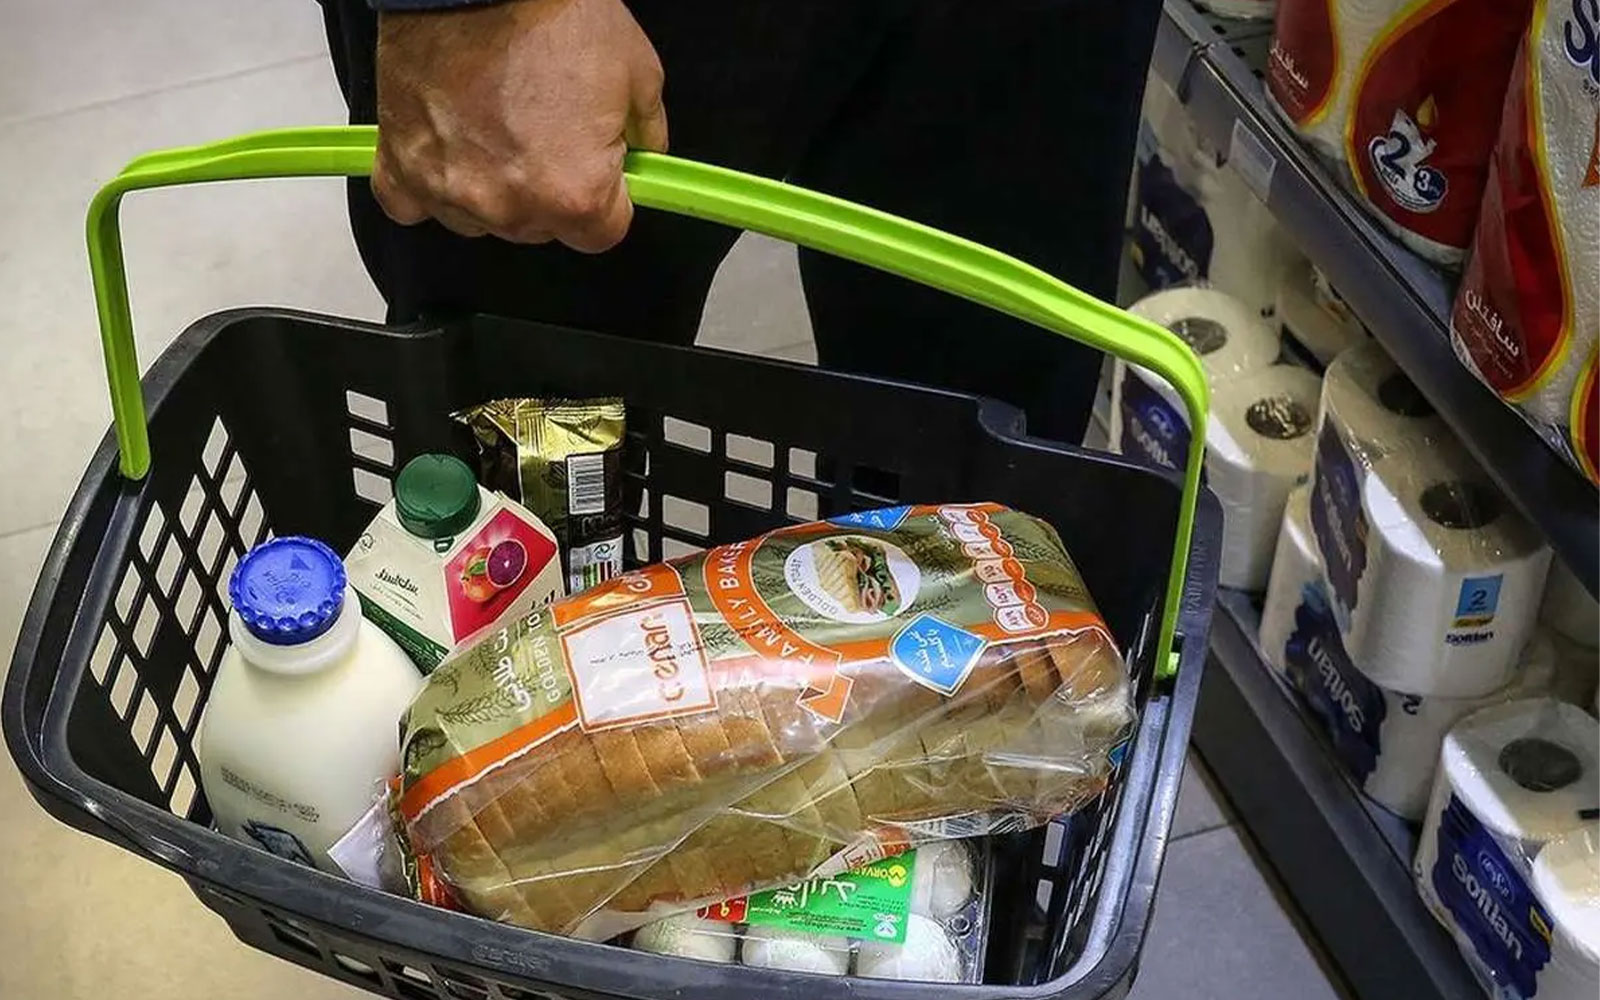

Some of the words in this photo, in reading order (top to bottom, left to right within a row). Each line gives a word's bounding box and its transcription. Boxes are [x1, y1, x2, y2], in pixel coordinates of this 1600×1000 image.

[1464, 288, 1520, 357] سافتلن
[1470, 589, 1488, 606] 2
[728, 598, 814, 665] FAMILY
[915, 648, 932, 673] شده
[530, 636, 561, 702] GOLDEN
[1307, 637, 1365, 733] Softlan
[1451, 853, 1523, 962] Softlan
